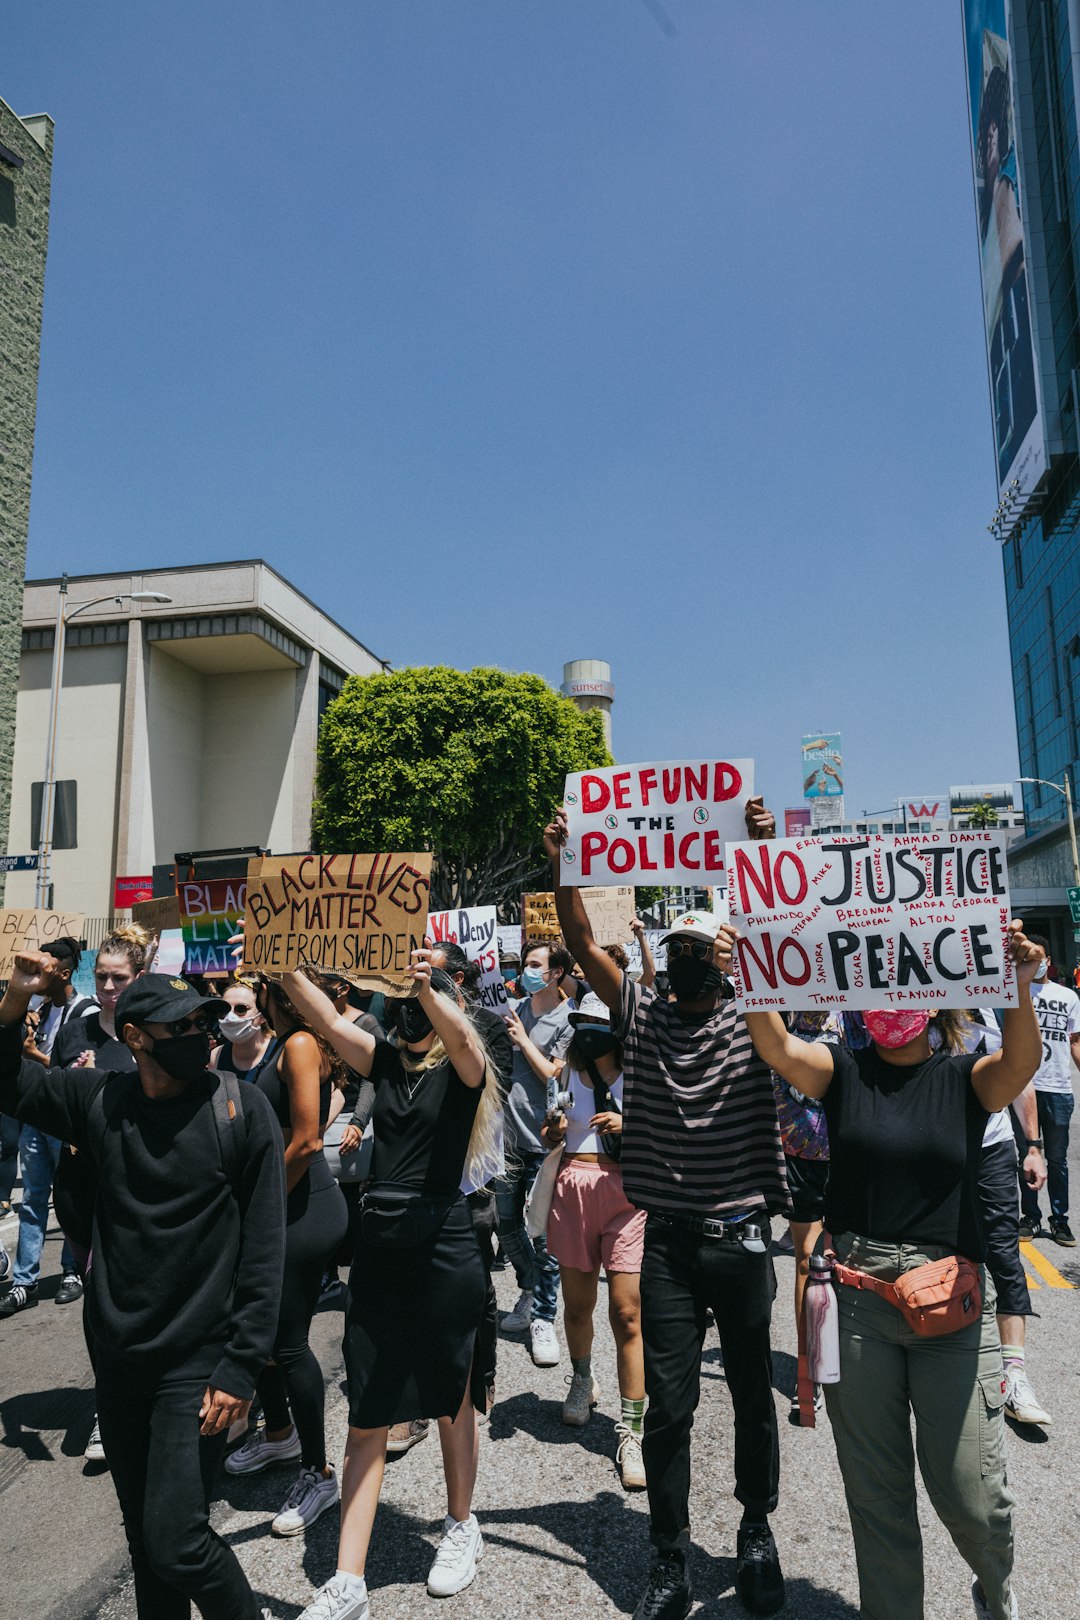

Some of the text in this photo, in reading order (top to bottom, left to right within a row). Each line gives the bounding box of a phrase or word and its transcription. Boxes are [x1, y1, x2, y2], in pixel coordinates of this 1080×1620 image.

[571, 684, 602, 692] sunset
[804, 748, 839, 760] besito
[581, 762, 742, 813] DEFUND
[907, 803, 940, 817] W
[627, 816, 675, 830] THE
[581, 829, 724, 876] POLICE
[795, 833, 992, 850] ERIC WALTER AHMAD DANTE
[25, 856, 36, 866] Wy
[873, 848, 885, 894] KENDREC
[980, 855, 990, 887] JEMEL
[118, 882, 134, 890] Bank
[734, 844, 1006, 914] NO JUSTICE
[811, 862, 832, 886] MIKE
[854, 860, 863, 897] AIYANA
[944, 859, 956, 896] JAMAR
[248, 853, 430, 930] BLACK LIVES
[904, 896, 999, 912] SANDRA GEORGE
[290, 892, 382, 931] MATTER
[530, 912, 560, 925] LIVE
[747, 911, 804, 928] PHILANDO
[791, 905, 821, 936] STEPHON
[836, 905, 894, 922] BREONNA
[847, 917, 890, 930] MICHEAL
[909, 914, 955, 928] ALTON
[1000, 907, 1009, 933] MORE
[3, 914, 78, 938] BLACK
[458, 910, 494, 952] Deny
[243, 933, 427, 970] LOVE FROM SWEDEN
[736, 924, 999, 992] NO PEACE
[815, 942, 827, 984] SANDRA
[886, 937, 897, 981] PAMELA
[922, 942, 933, 969] TONY
[960, 928, 976, 976] TANISHA
[853, 952, 863, 988] OSCAR
[745, 997, 786, 1008] FREDDIE
[808, 993, 847, 1005] TAMIR
[885, 989, 947, 1002] TRAYVON
[965, 985, 1000, 997] SEAN
